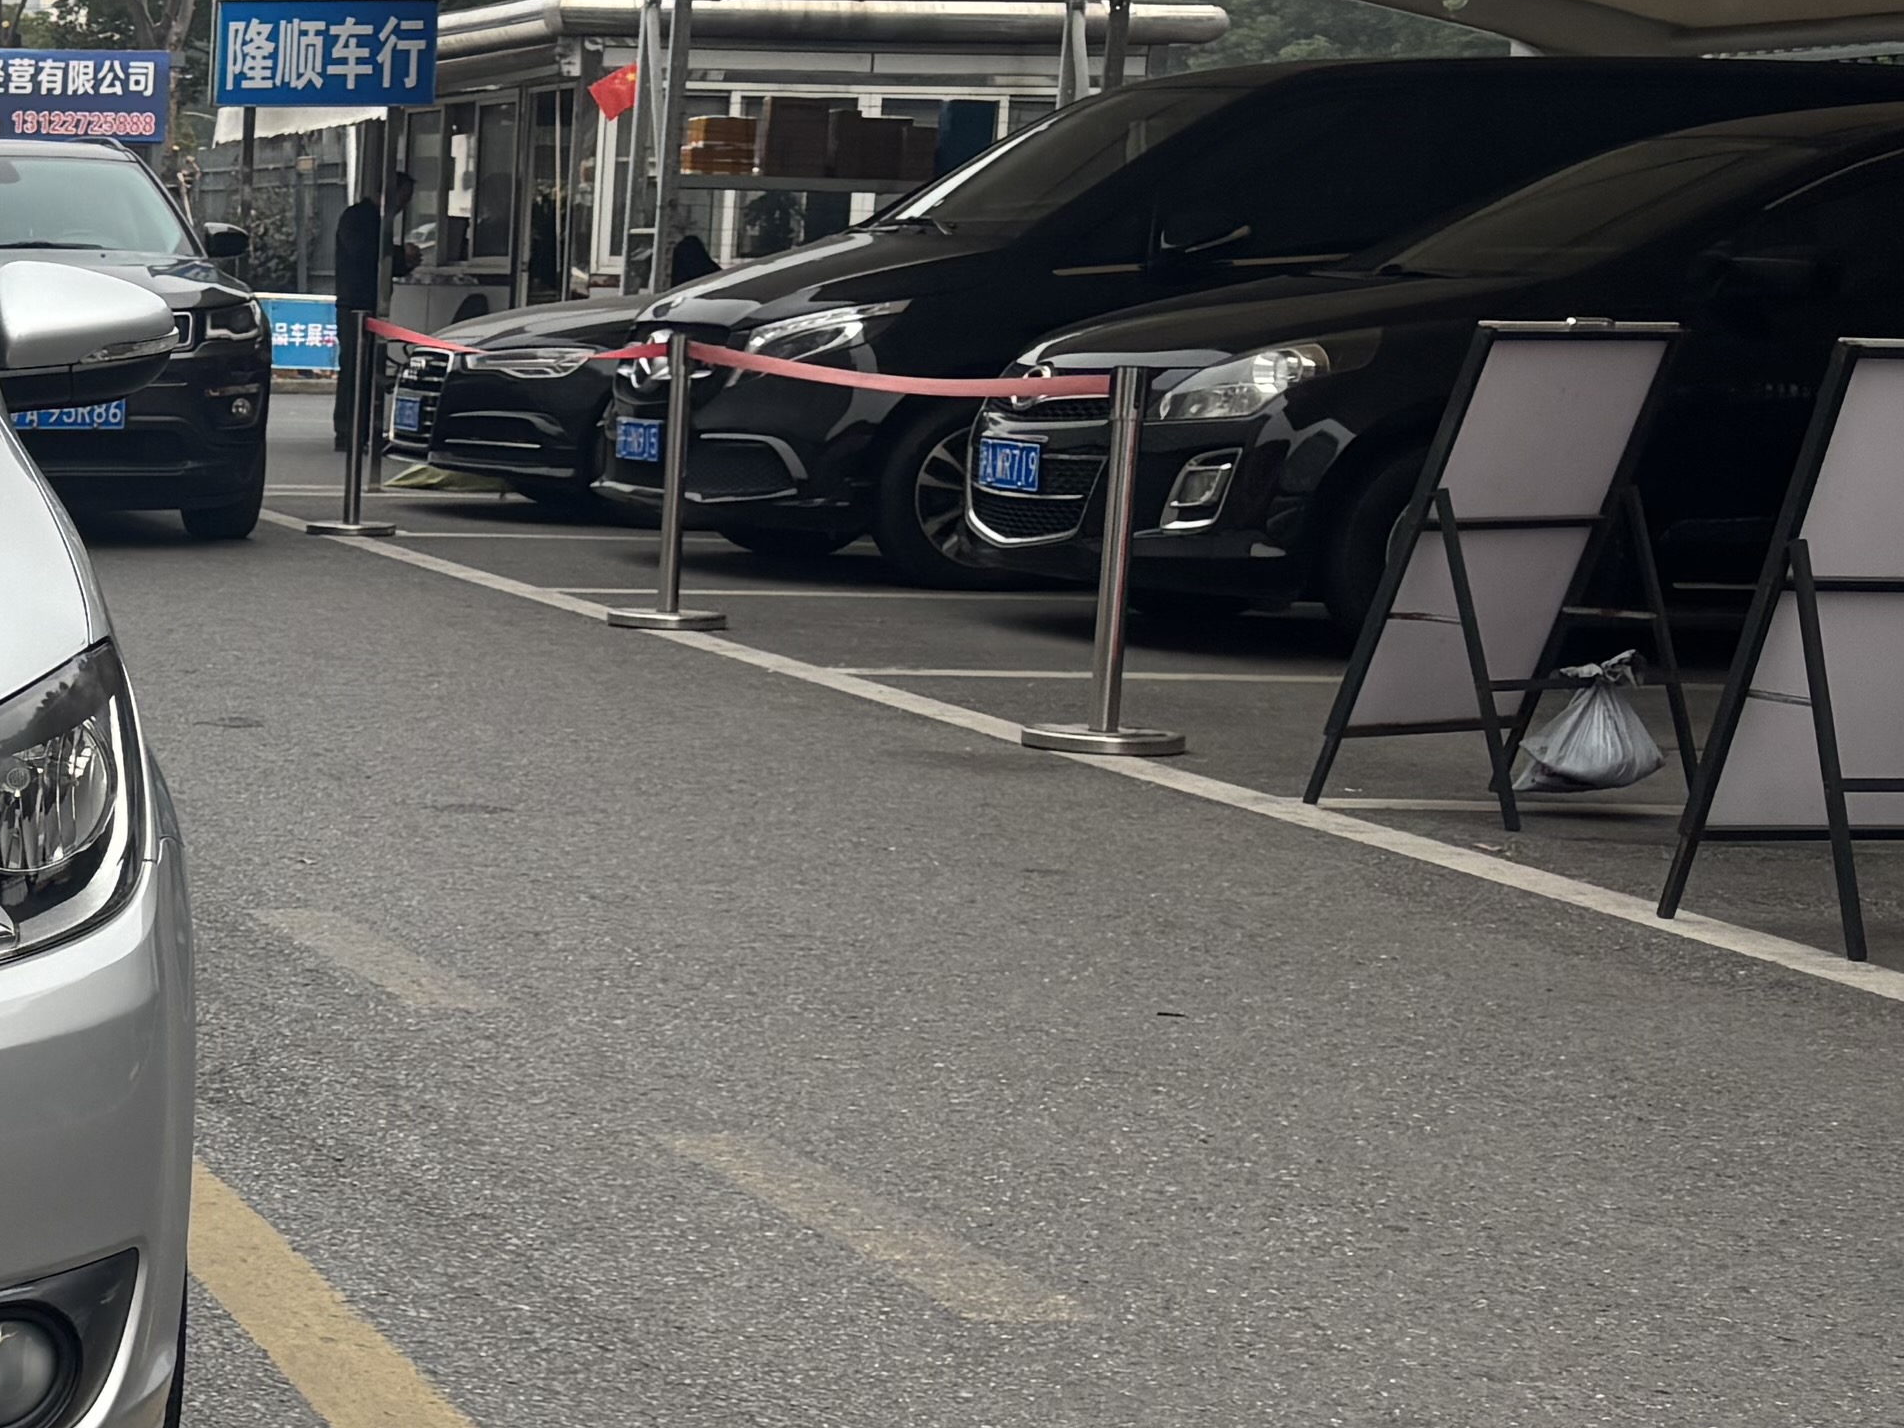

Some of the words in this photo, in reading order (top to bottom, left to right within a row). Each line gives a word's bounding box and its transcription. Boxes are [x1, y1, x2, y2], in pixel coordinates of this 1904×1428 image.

[226, 15, 427, 91] 隆顺车行
[12, 110, 155, 135] 13122725888
